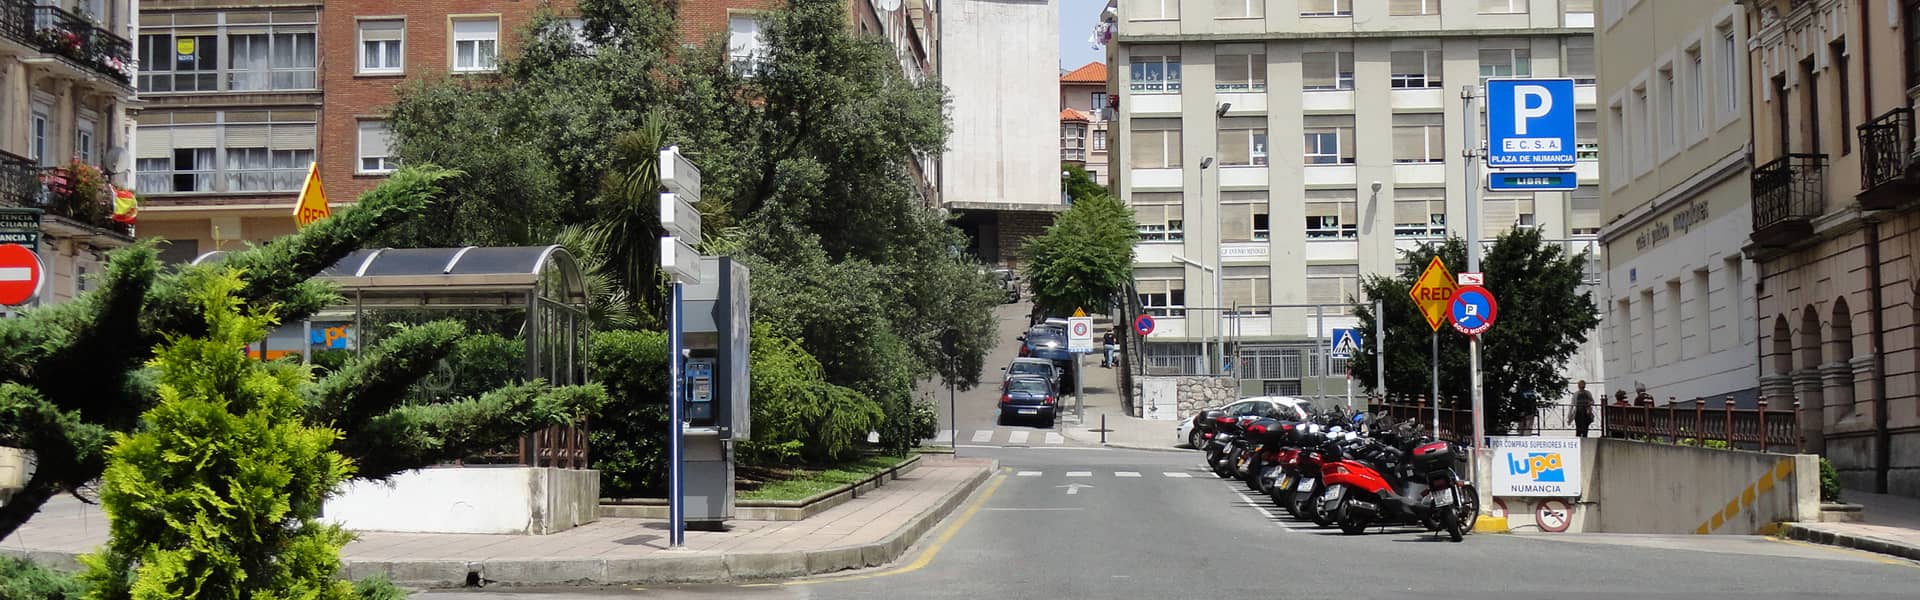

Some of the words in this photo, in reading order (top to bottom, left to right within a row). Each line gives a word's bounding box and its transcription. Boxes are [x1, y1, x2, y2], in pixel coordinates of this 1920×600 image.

[1514, 85, 1552, 135] P
[1491, 155, 1517, 163] PLAZA
[1533, 154, 1574, 162] NUMANCIA
[1516, 177, 1550, 185] LIBRE
[1420, 287, 1452, 301] RED
[1453, 322, 1469, 334] SOLO
[1470, 322, 1490, 334] MOTOS
[1529, 440, 1561, 448] SUPERIORES
[1507, 452, 1562, 478] lupa
